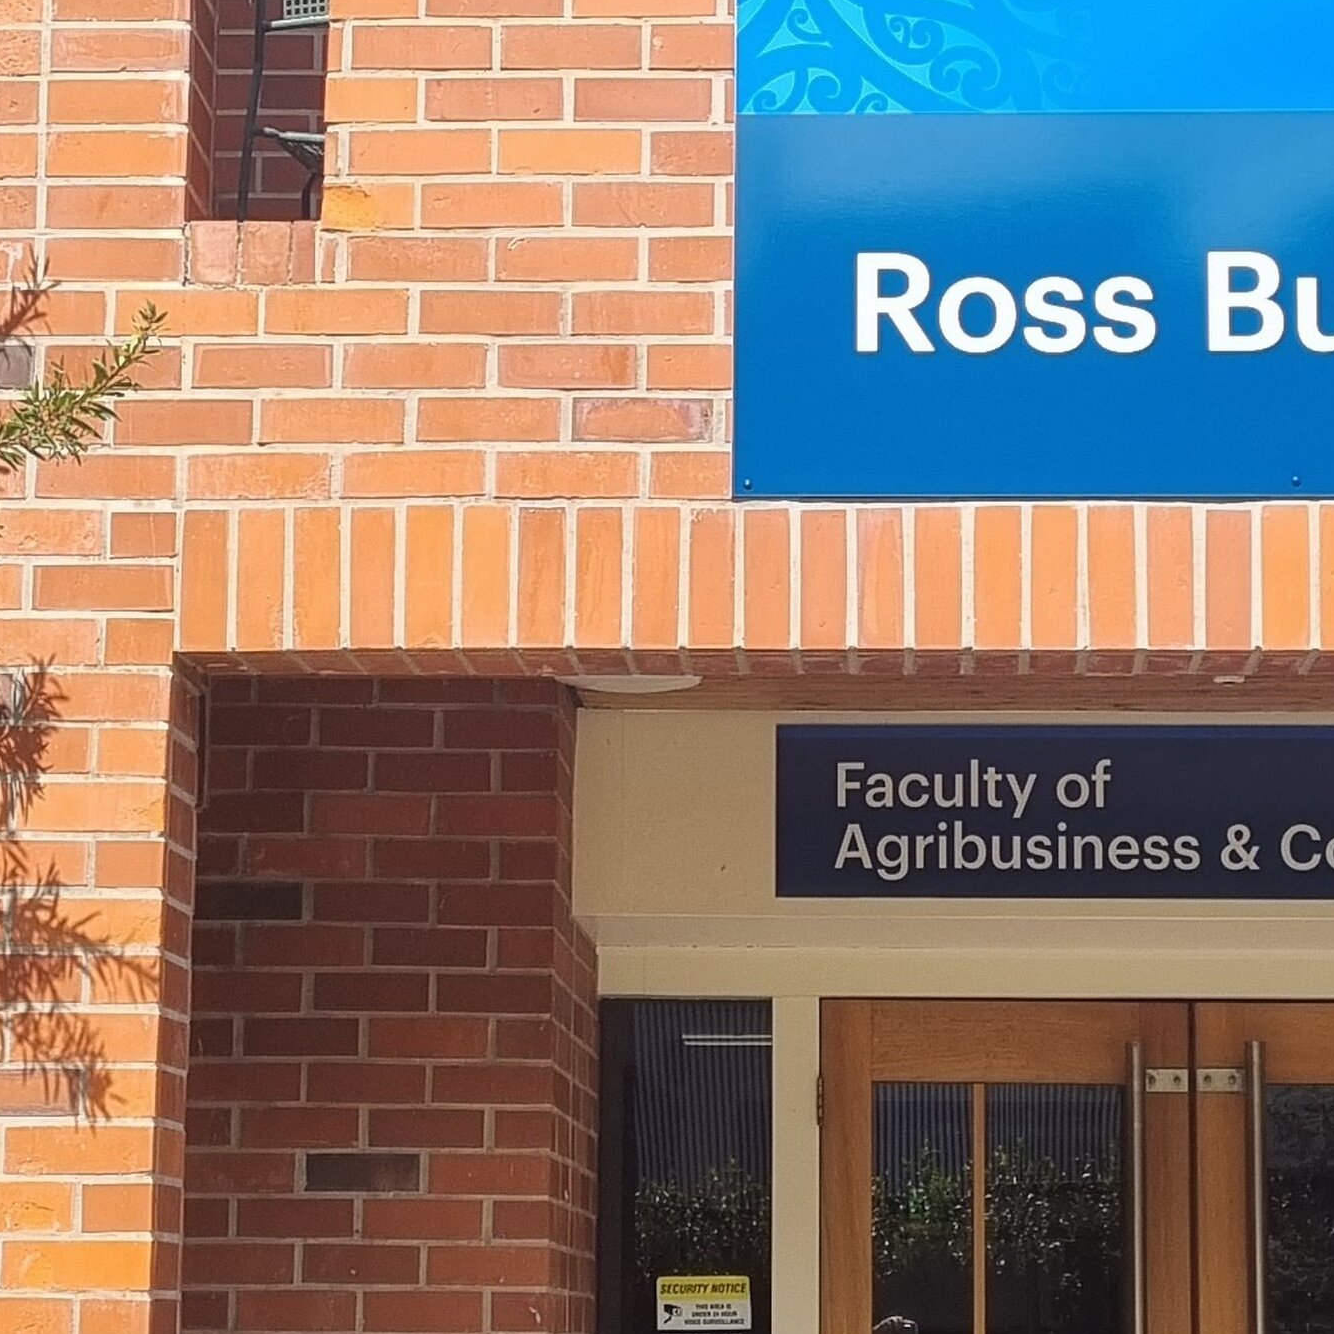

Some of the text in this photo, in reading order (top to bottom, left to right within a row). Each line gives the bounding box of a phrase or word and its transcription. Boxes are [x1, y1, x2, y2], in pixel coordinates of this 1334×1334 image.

[856, 252, 1157, 354] Ross
[836, 759, 1112, 818] Faculty of
[834, 822, 1201, 880] Agribusiness
[1220, 824, 1261, 872] &
[660, 1282, 747, 1295] SECURITY NOTICE
